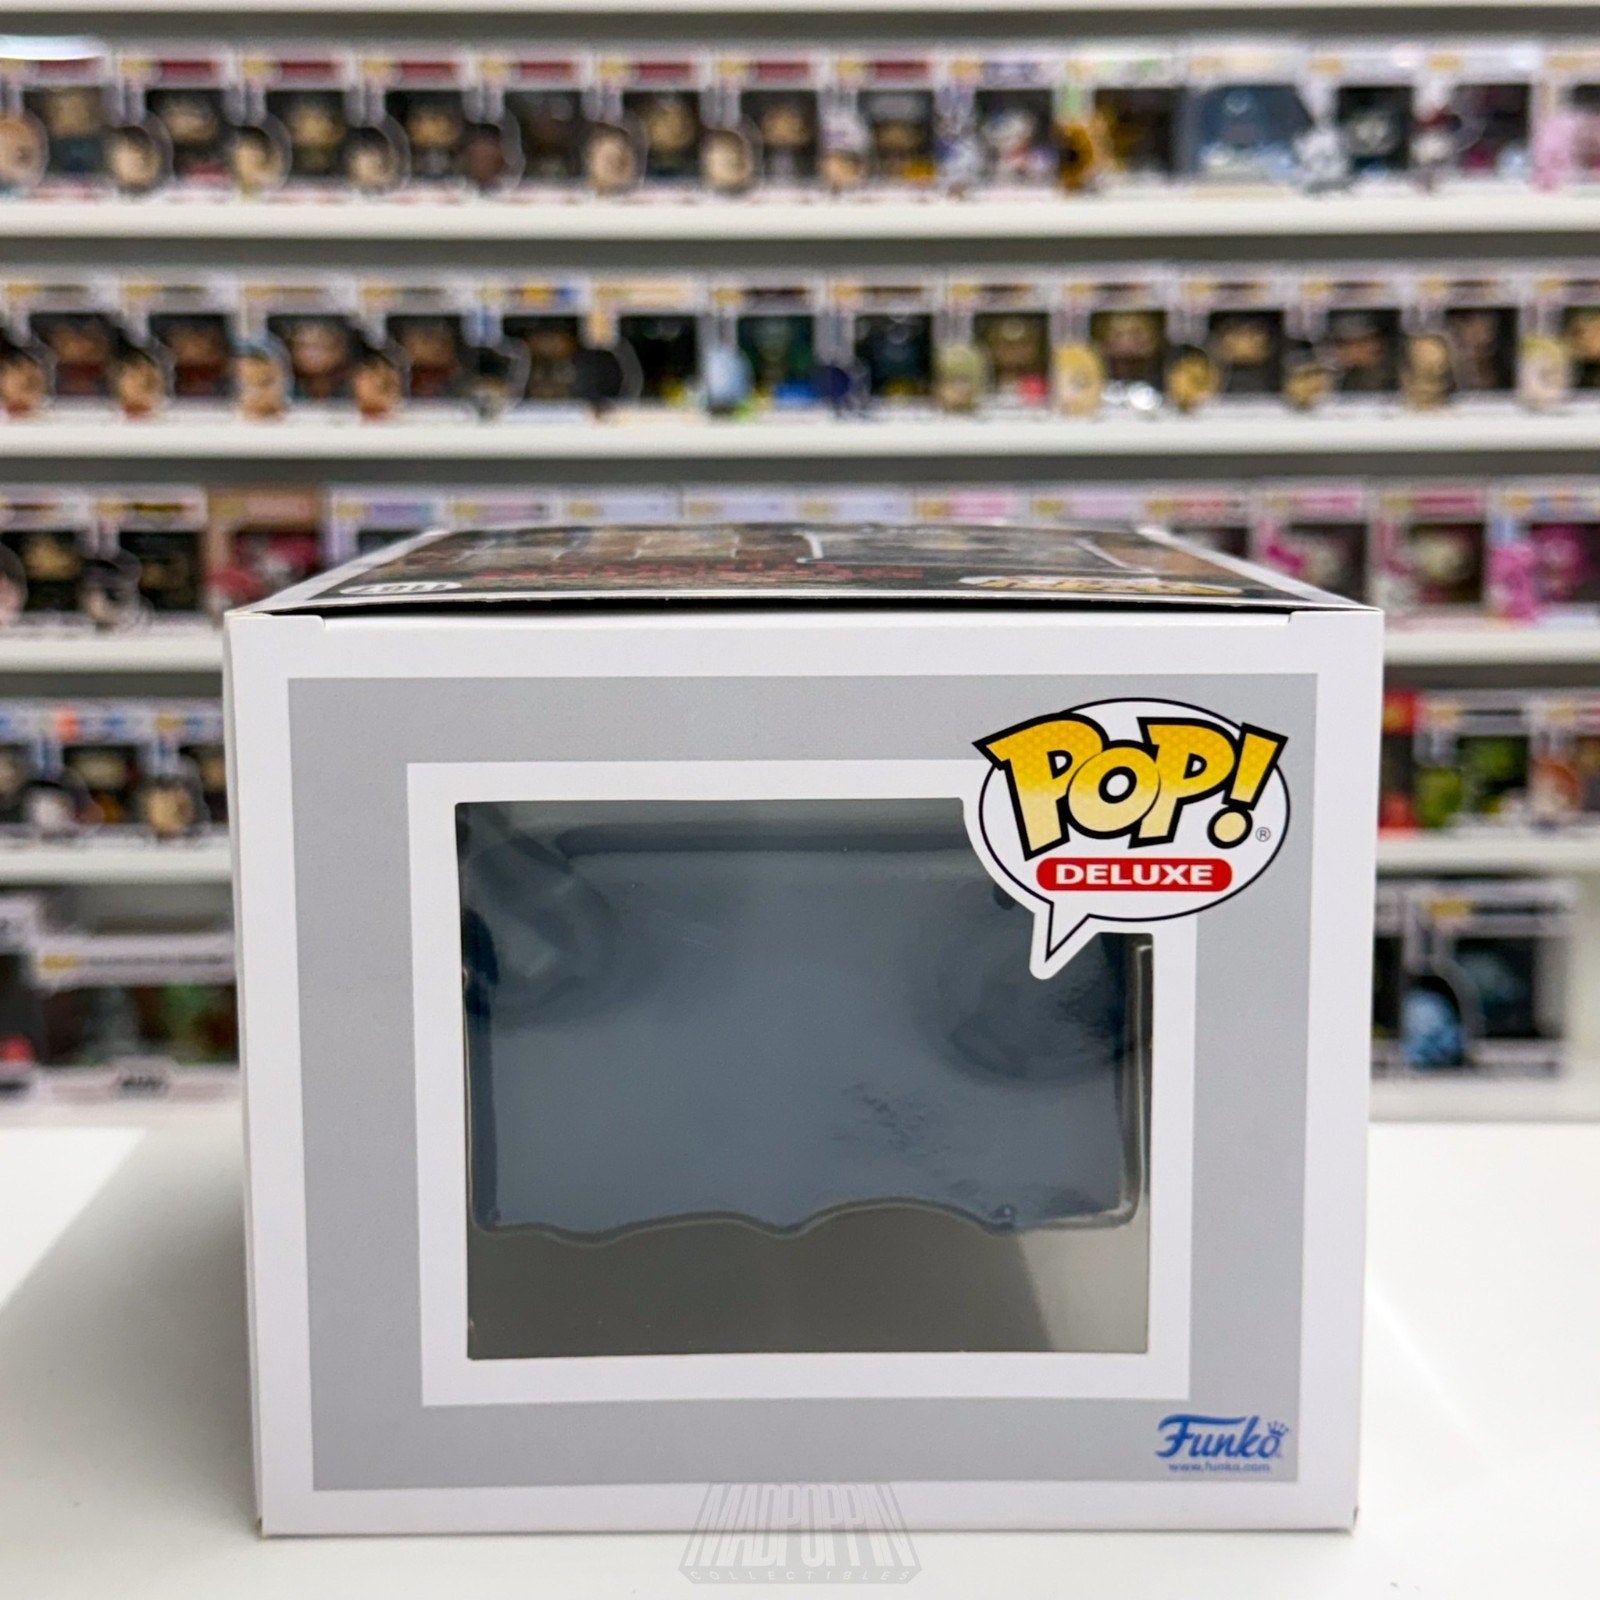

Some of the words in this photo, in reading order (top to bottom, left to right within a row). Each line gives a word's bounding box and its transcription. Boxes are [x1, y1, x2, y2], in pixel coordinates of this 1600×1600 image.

[1055, 864, 1213, 885] DELUXE
[1156, 1414, 1282, 1458] Funko
[1168, 1462, 1270, 1473] www.funko.com
